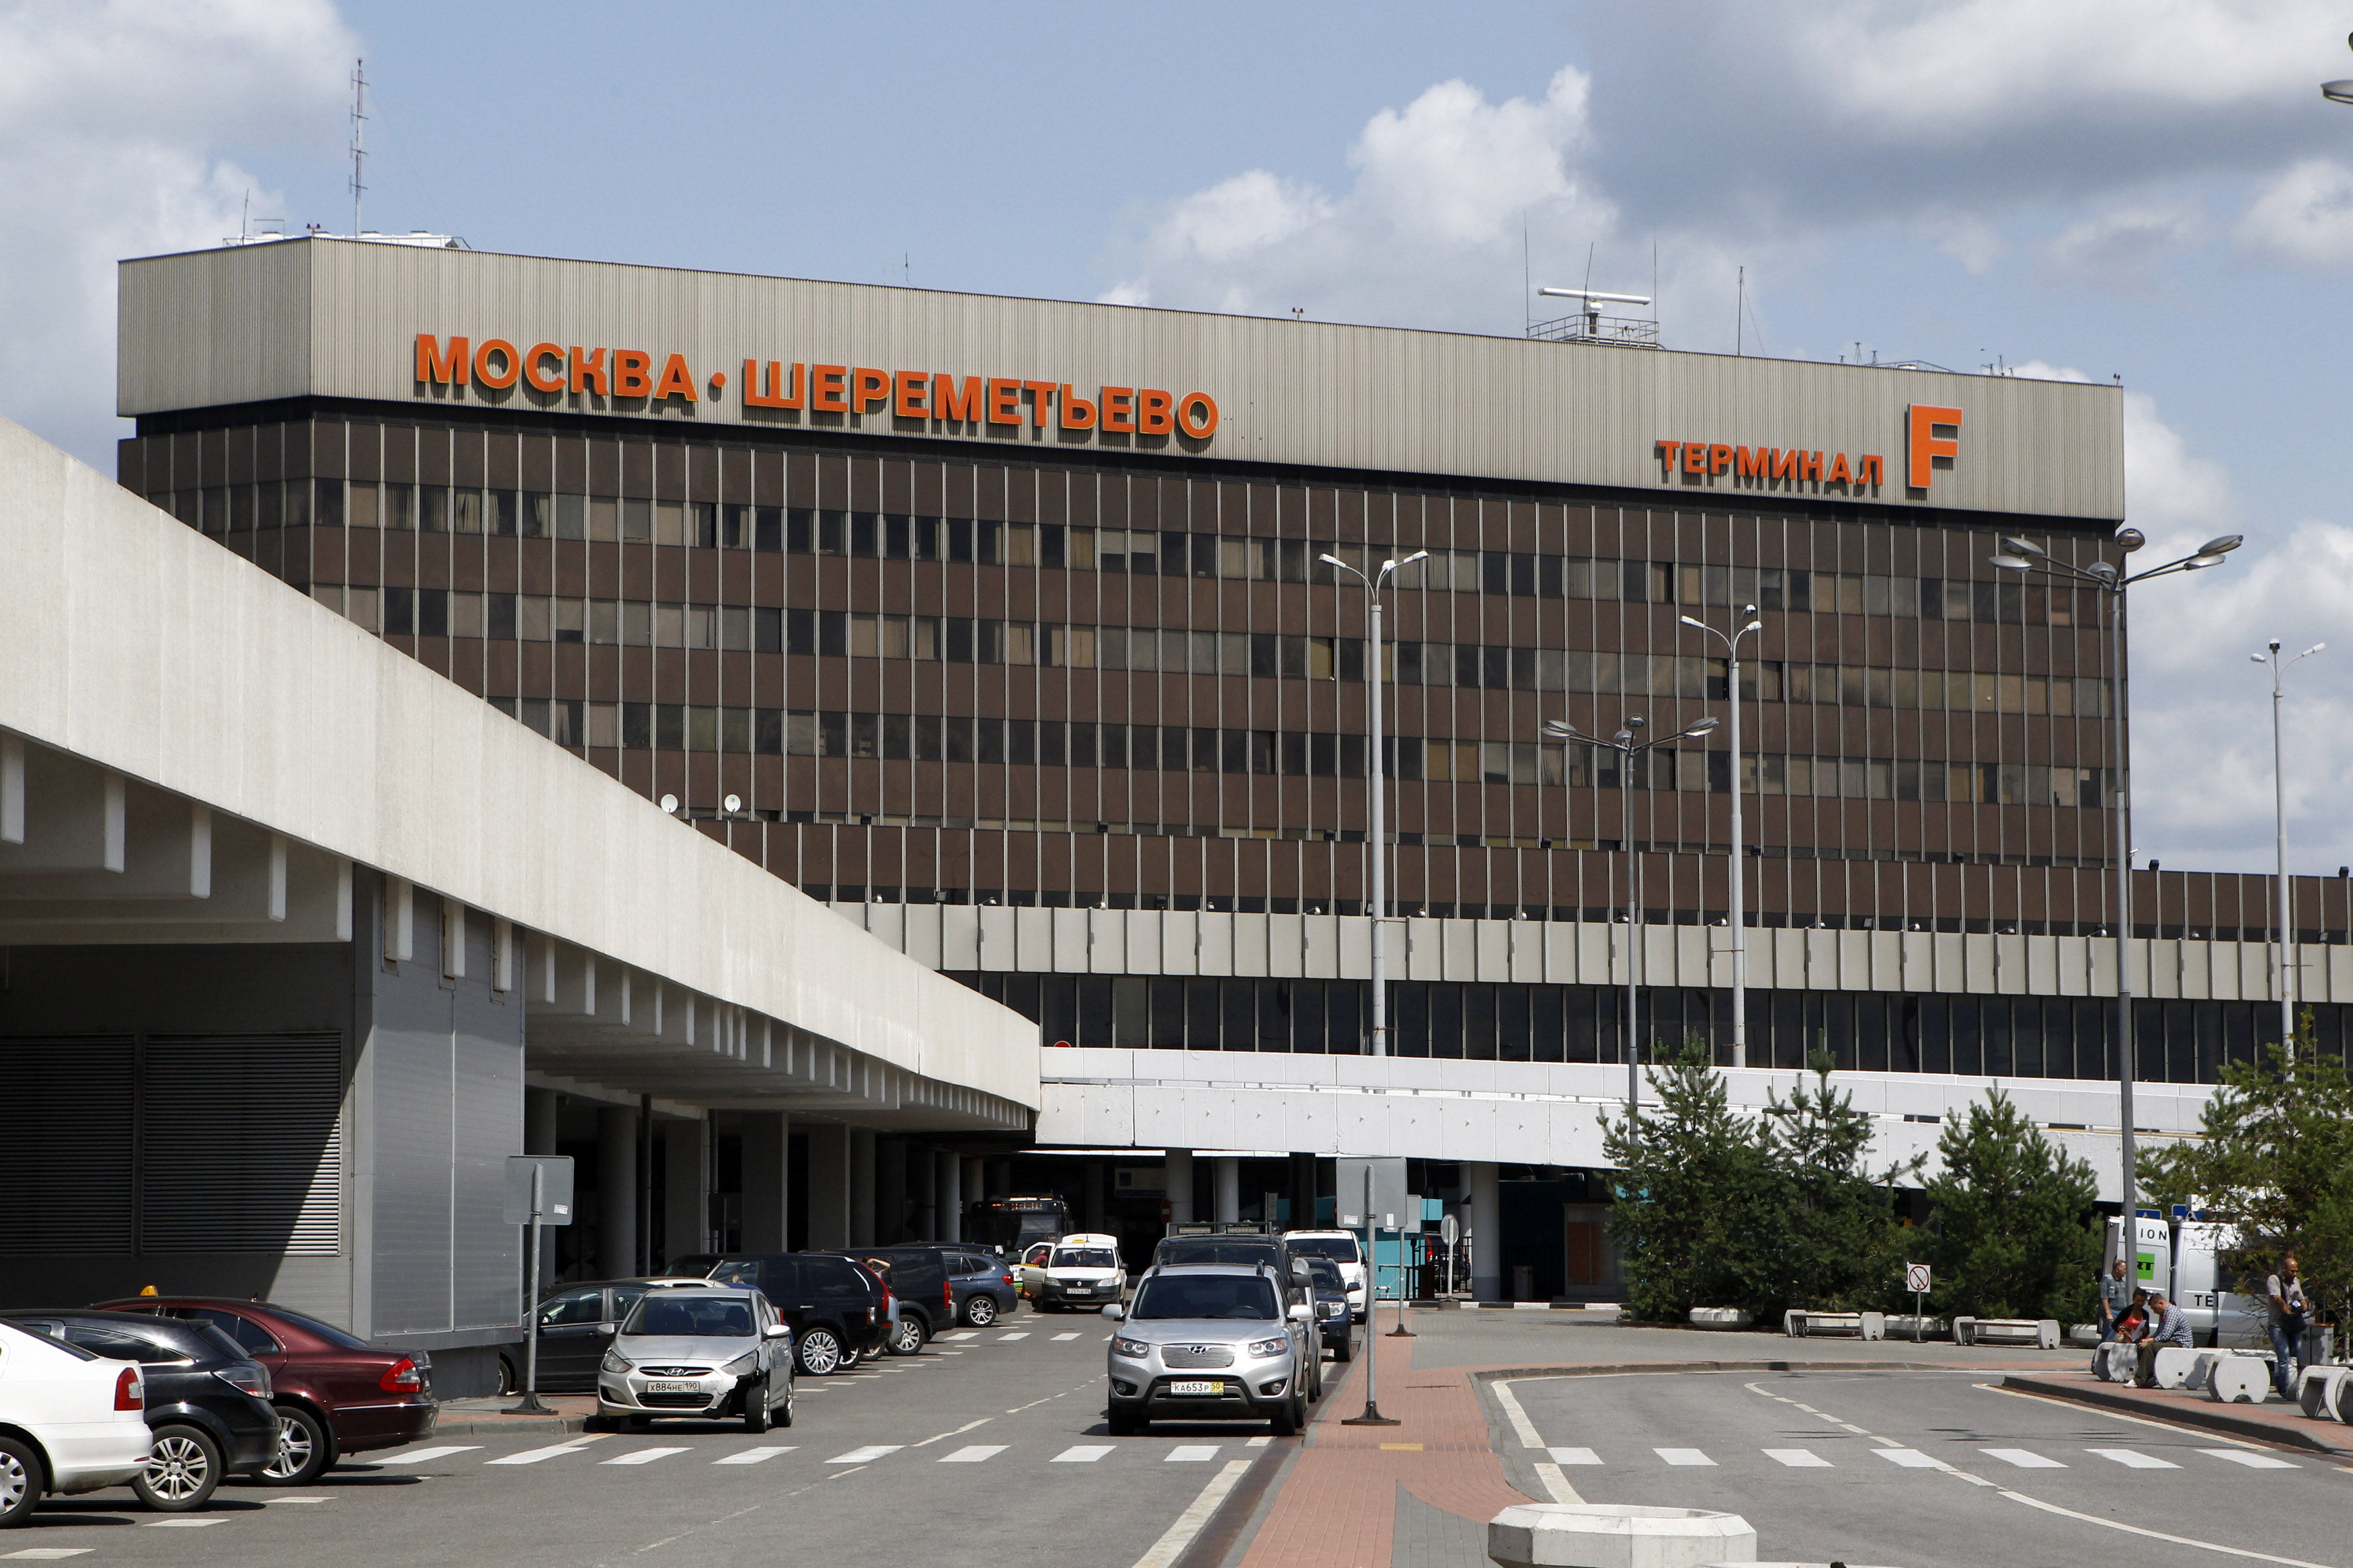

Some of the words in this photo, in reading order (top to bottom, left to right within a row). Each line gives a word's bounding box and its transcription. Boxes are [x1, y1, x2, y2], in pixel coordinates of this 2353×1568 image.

[415, 333, 699, 402] МОСКВА
[744, 358, 1218, 440] ШЕРЕМЕТЬЕВО
[1657, 440, 1884, 485] ТЕРМИНАЛ
[1908, 404, 1962, 489] F
